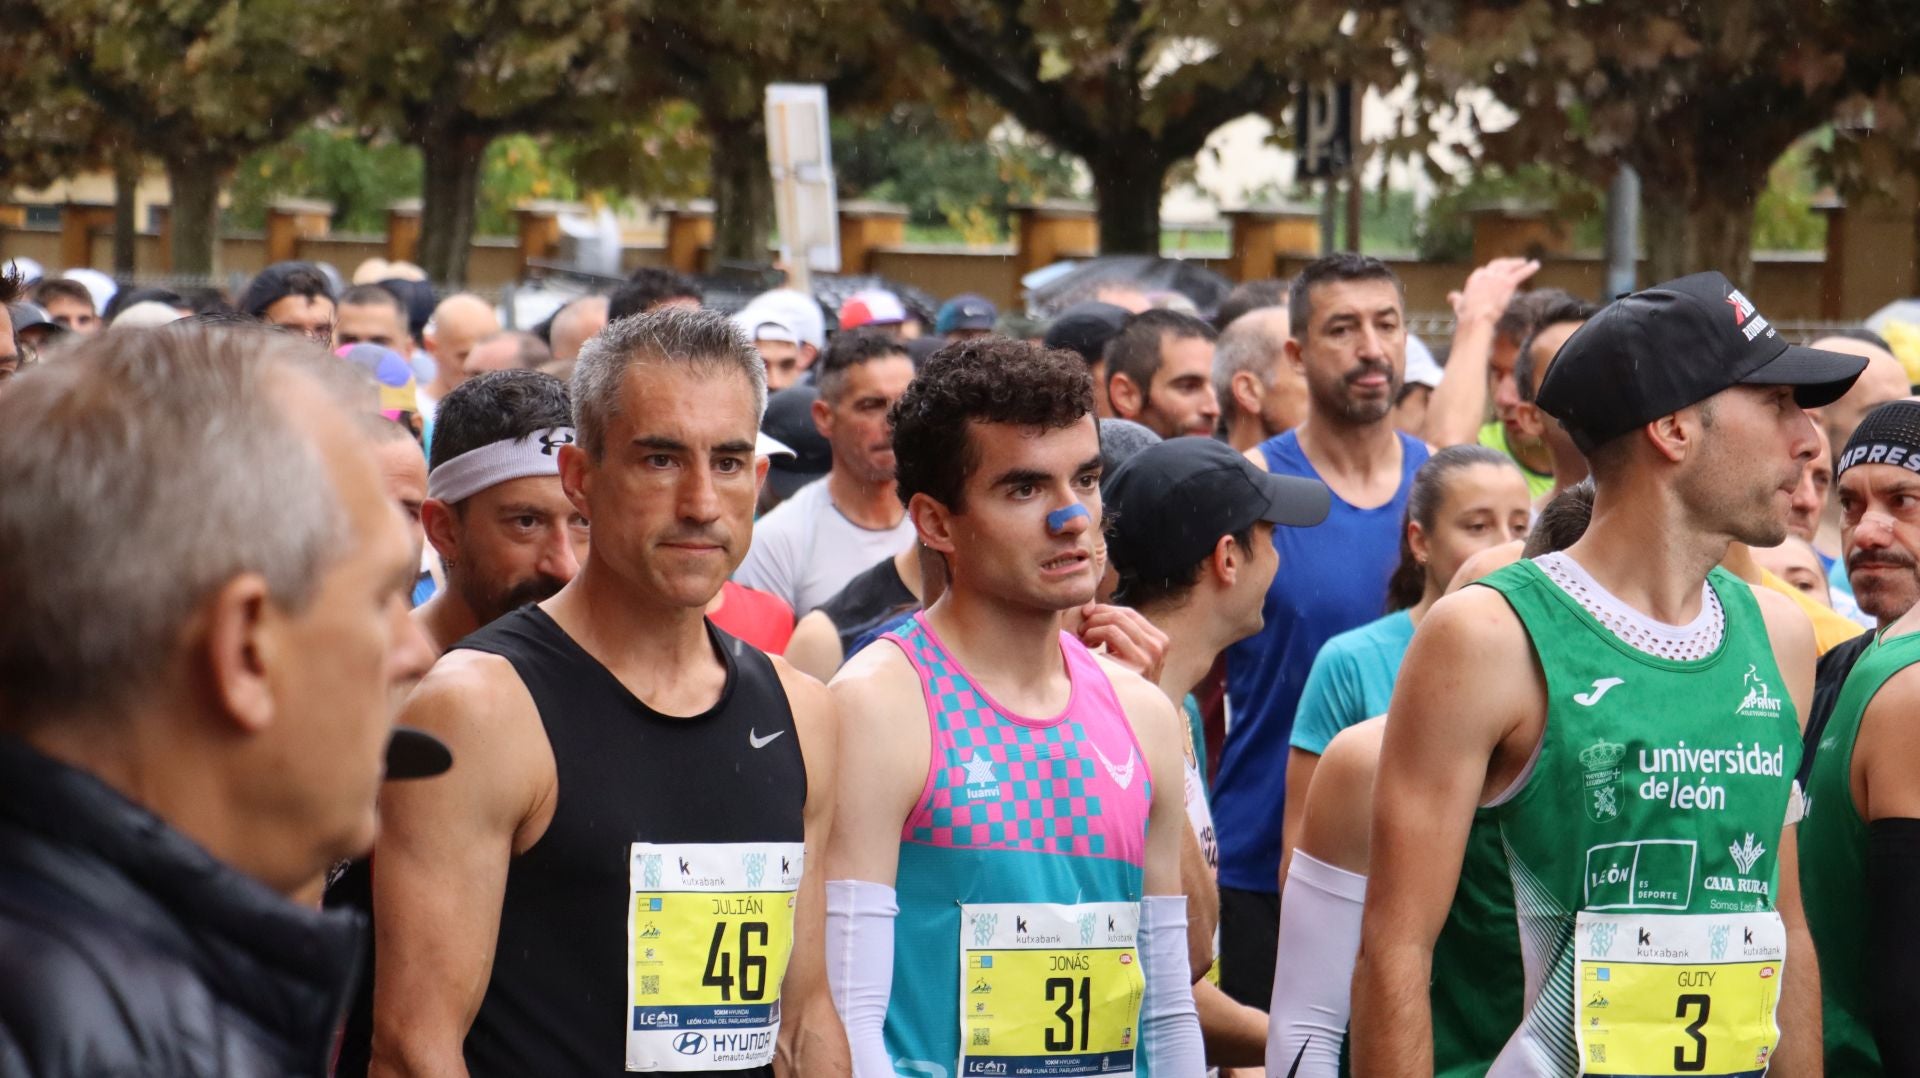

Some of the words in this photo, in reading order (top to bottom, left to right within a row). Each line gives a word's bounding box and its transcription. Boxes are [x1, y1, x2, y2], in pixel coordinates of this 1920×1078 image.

[1744, 696, 1781, 711] SPRINT
[1639, 740, 1783, 777] universidad
[967, 786, 1000, 799] luanvi
[1639, 776, 1669, 800] de
[1669, 777, 1725, 810] león
[680, 856, 691, 876] k
[781, 855, 790, 875] k
[682, 877, 725, 888] kutxabank
[1592, 863, 1629, 888] LEÓN
[1639, 880, 1649, 888] ES
[1704, 876, 1736, 892] CAJA
[1638, 891, 1677, 900] DEPORTE
[712, 896, 763, 915] JULIÁN
[1710, 899, 1739, 911] Somos
[1016, 915, 1027, 933] k
[1107, 914, 1115, 932] k
[1016, 935, 1061, 944] kutxabank
[1107, 934, 1133, 943] kutxabank
[1638, 927, 1650, 946] k
[1744, 926, 1753, 945] k
[1637, 948, 1689, 959] kutxabank
[1743, 945, 1781, 956] kutxabank
[702, 921, 768, 1001] 46
[1049, 953, 1090, 971] JONÁS
[1678, 971, 1717, 987] GUTY
[1045, 977, 1091, 1052] 31
[1674, 994, 1711, 1072] 3
[713, 1053, 745, 1062] Lemauto
